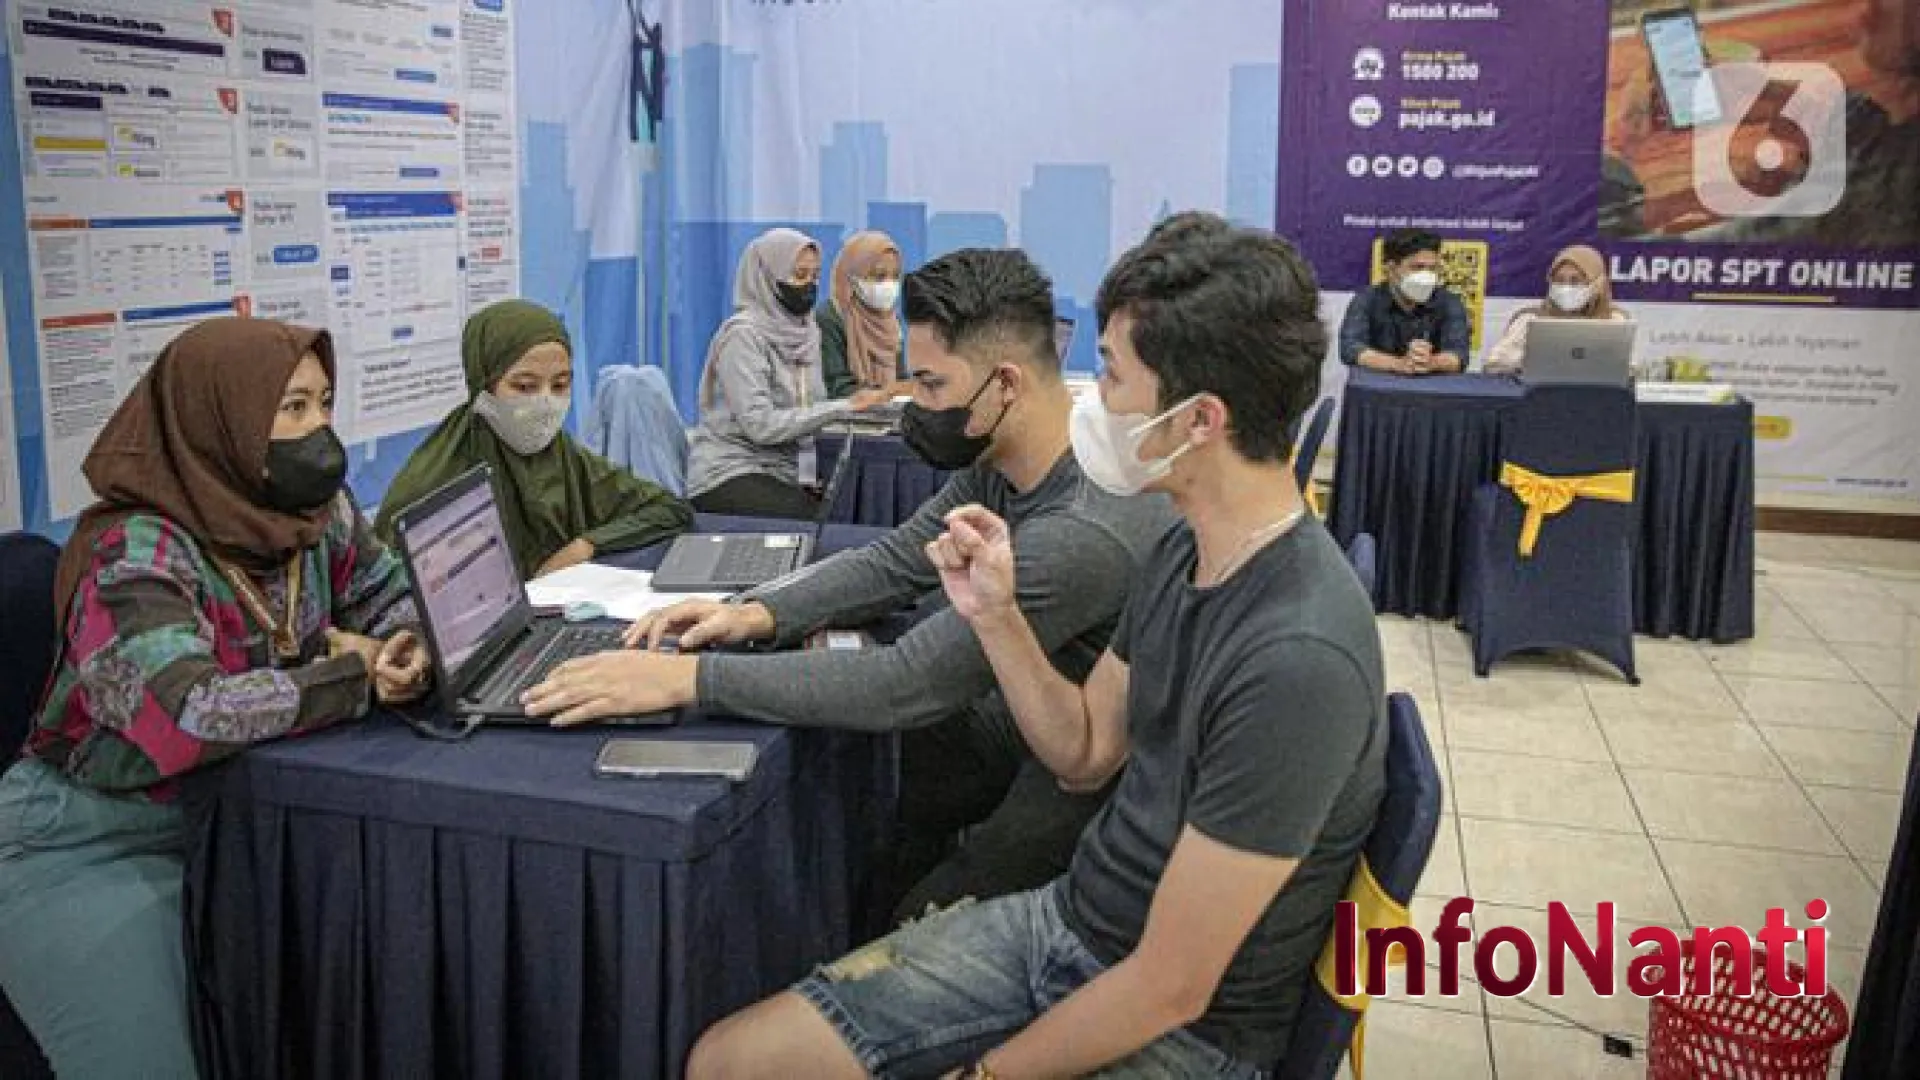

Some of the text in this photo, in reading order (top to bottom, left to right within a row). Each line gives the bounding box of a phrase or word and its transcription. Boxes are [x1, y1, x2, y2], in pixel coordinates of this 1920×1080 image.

[1387, 3, 1447, 20] Kontak
[1402, 63, 1479, 80] 1500 200
[1398, 109, 1495, 131] pajak.go.id
[1611, 255, 1915, 290] LAPOR SPT ONLINE
